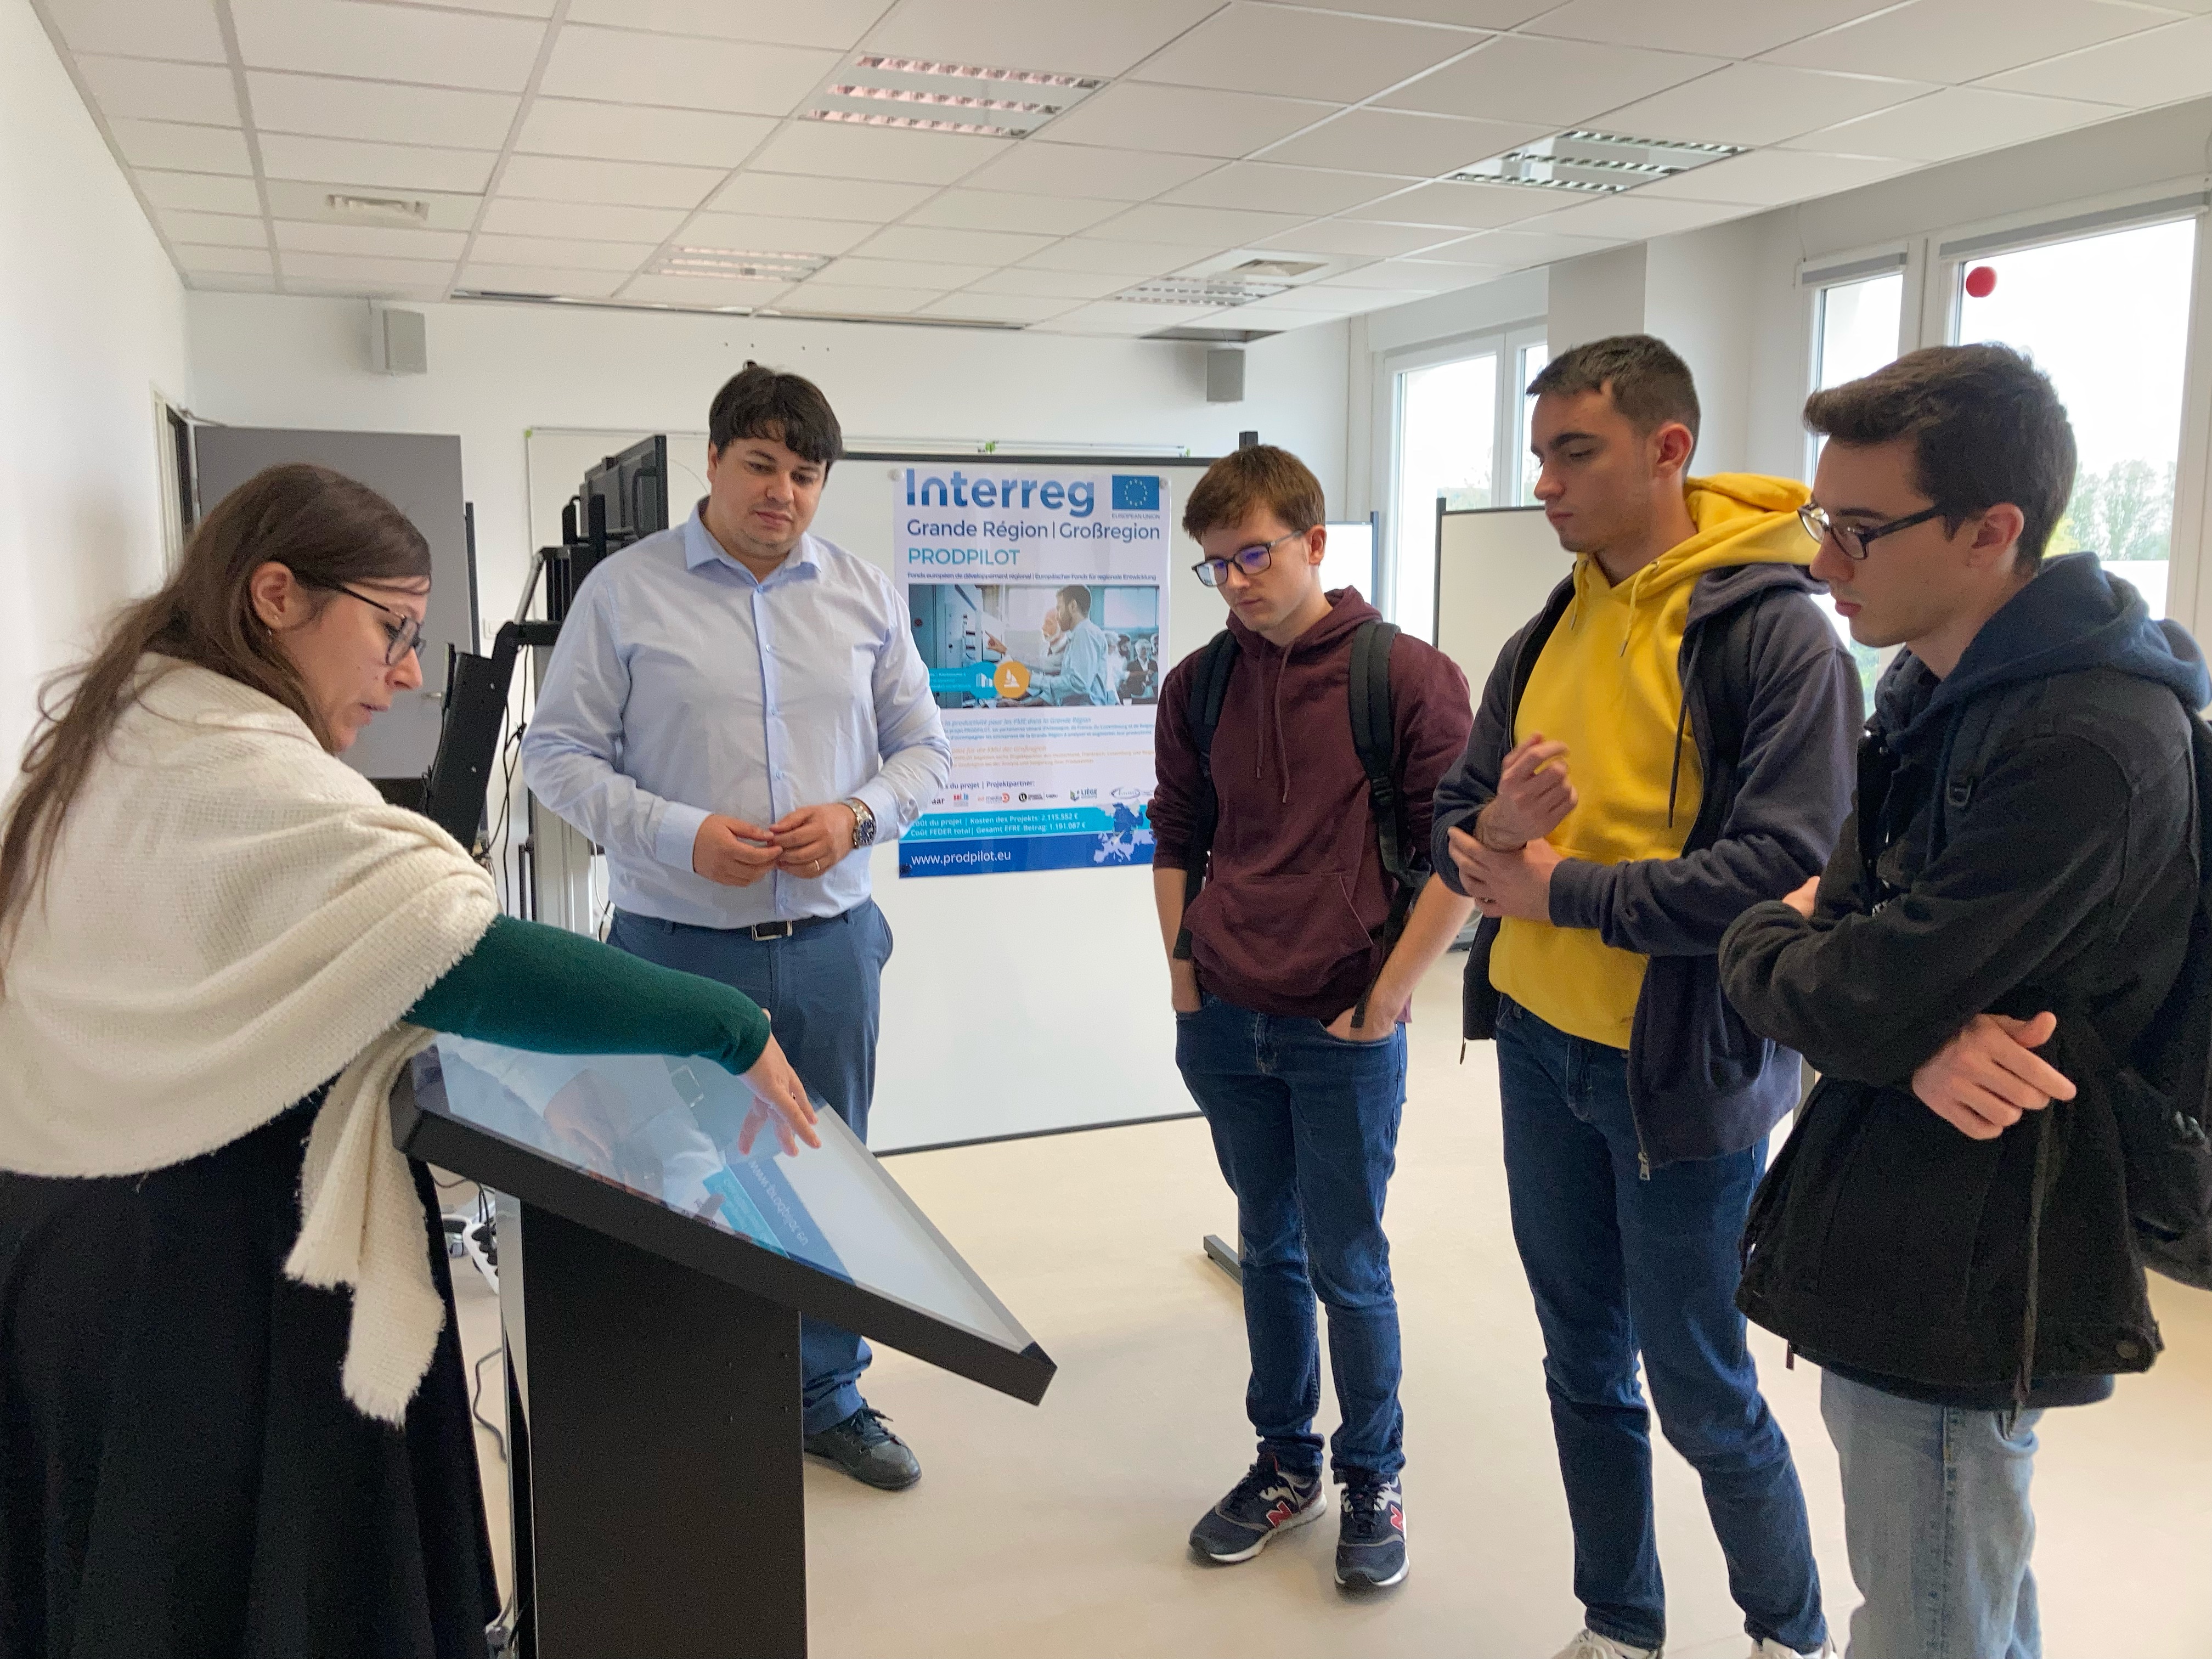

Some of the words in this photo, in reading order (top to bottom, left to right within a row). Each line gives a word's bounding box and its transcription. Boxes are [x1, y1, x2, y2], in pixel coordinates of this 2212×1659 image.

[906, 468, 1095, 517] Interreg
[907, 518, 977, 537] Grande
[984, 520, 1048, 541] Région
[1060, 522, 1160, 543] Großregion
[908, 549, 1020, 565] PRODPILOT
[960, 782, 980, 791] projet
[986, 780, 1035, 790] Projektpartner:
[931, 797, 945, 805] aar
[940, 818, 962, 828] projet
[970, 816, 994, 825] Kosten
[996, 815, 1008, 823] des
[910, 828, 927, 837] Coût
[929, 827, 952, 836] FEDER
[976, 826, 1003, 834] Gesamt
[911, 850, 1012, 867] www.prodpilot.eu
